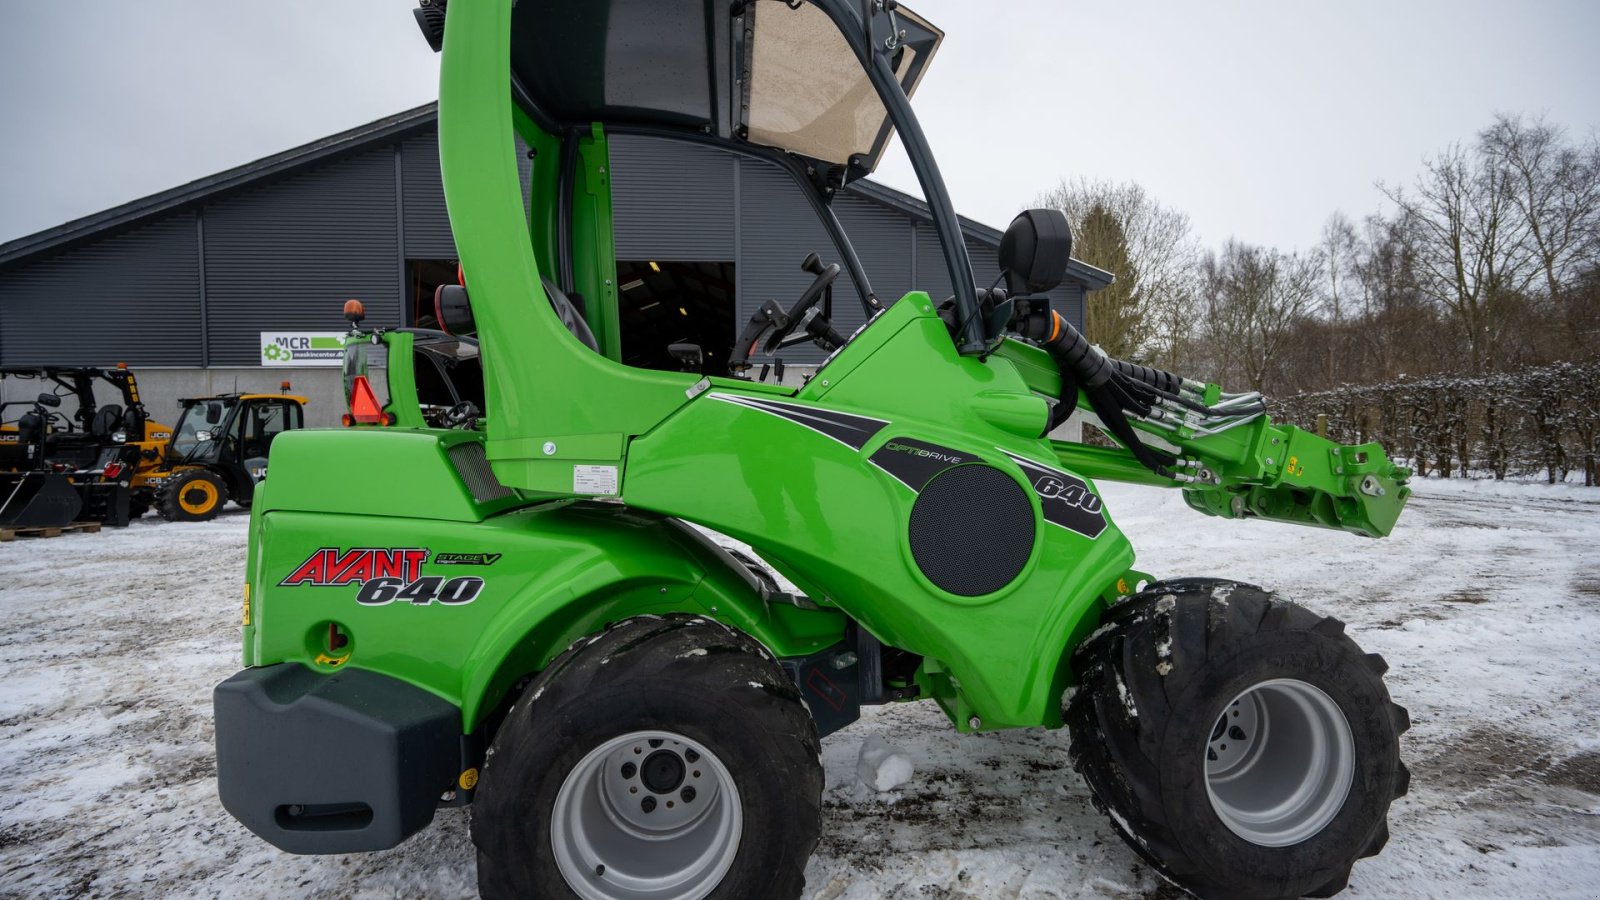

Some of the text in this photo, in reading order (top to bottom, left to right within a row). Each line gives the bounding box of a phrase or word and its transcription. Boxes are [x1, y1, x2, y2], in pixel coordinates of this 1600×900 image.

[276, 337, 310, 349] MCR
[885, 442, 962, 464] OPTIDRIVE
[1034, 475, 1103, 514] 640
[279, 548, 428, 587] AVANT
[355, 576, 486, 606] 640
